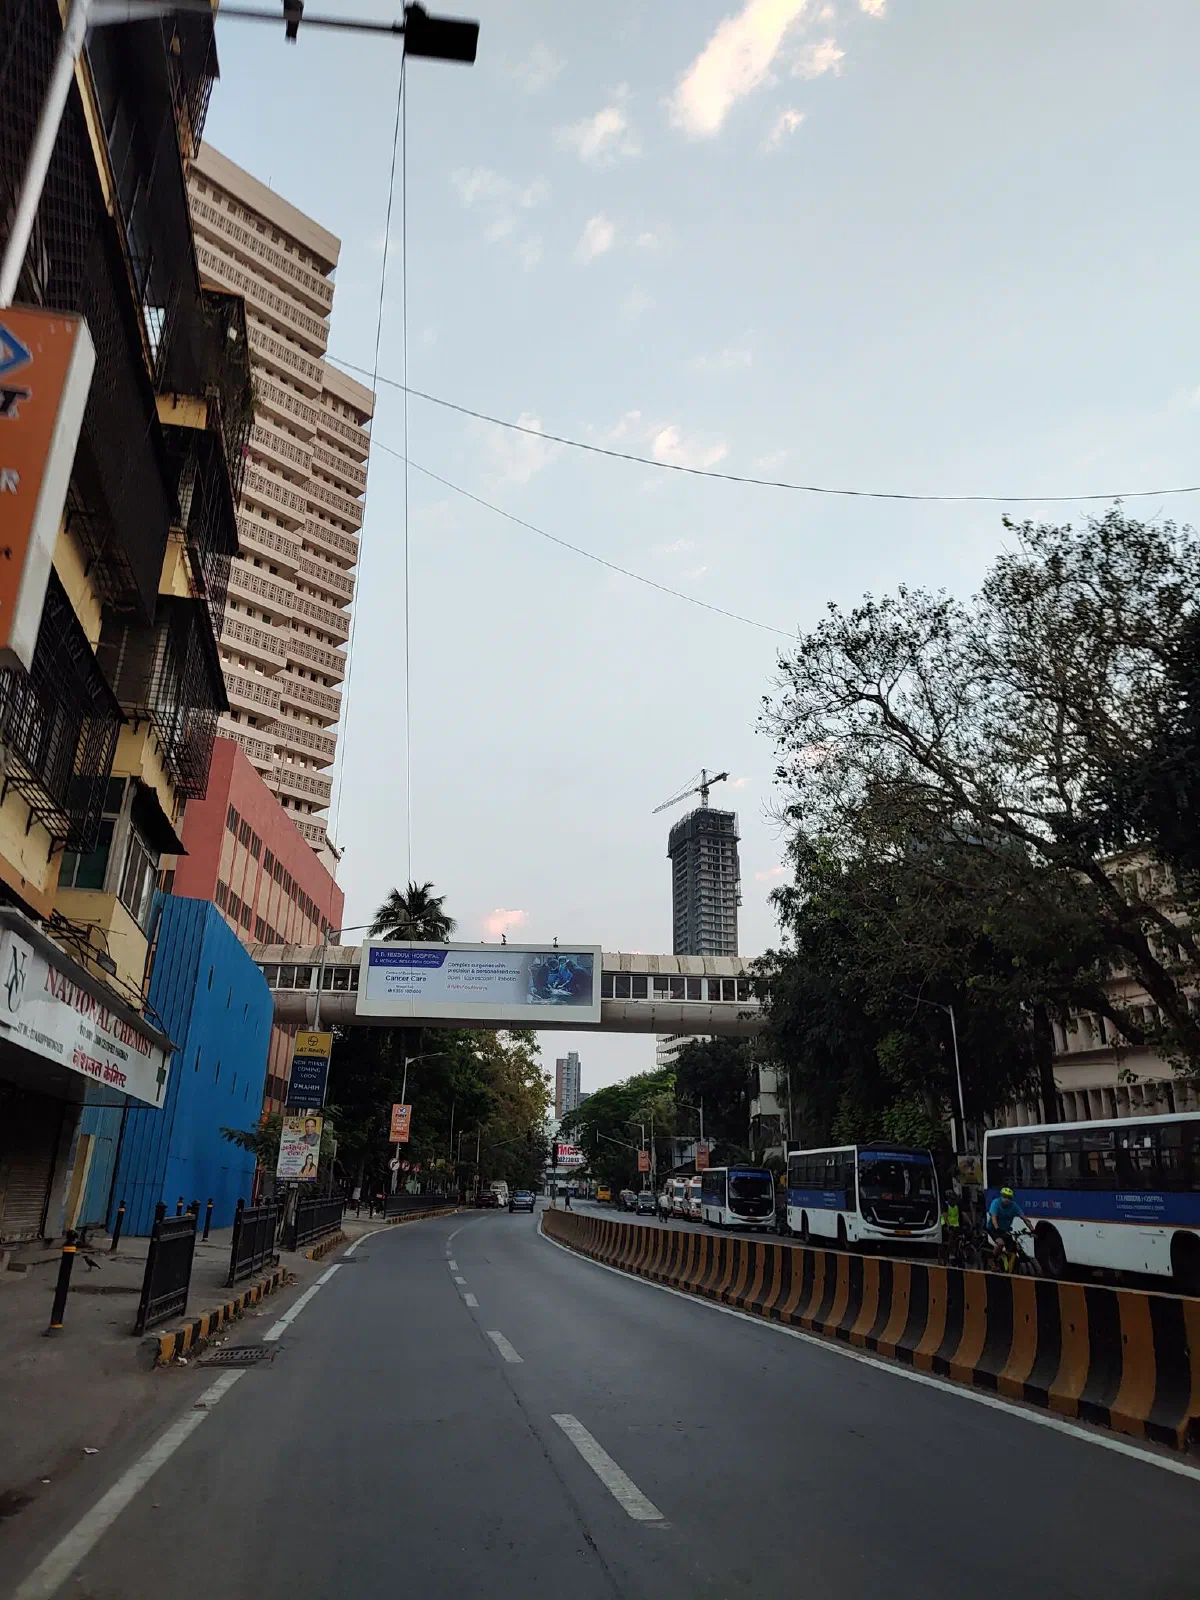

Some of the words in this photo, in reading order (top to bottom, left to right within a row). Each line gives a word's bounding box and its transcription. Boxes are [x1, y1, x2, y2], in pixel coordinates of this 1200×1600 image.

[44, 963, 112, 1034] NATIONAL
[113, 1018, 154, 1059] CHEMIST
[308, 1047, 327, 1055] Realty
